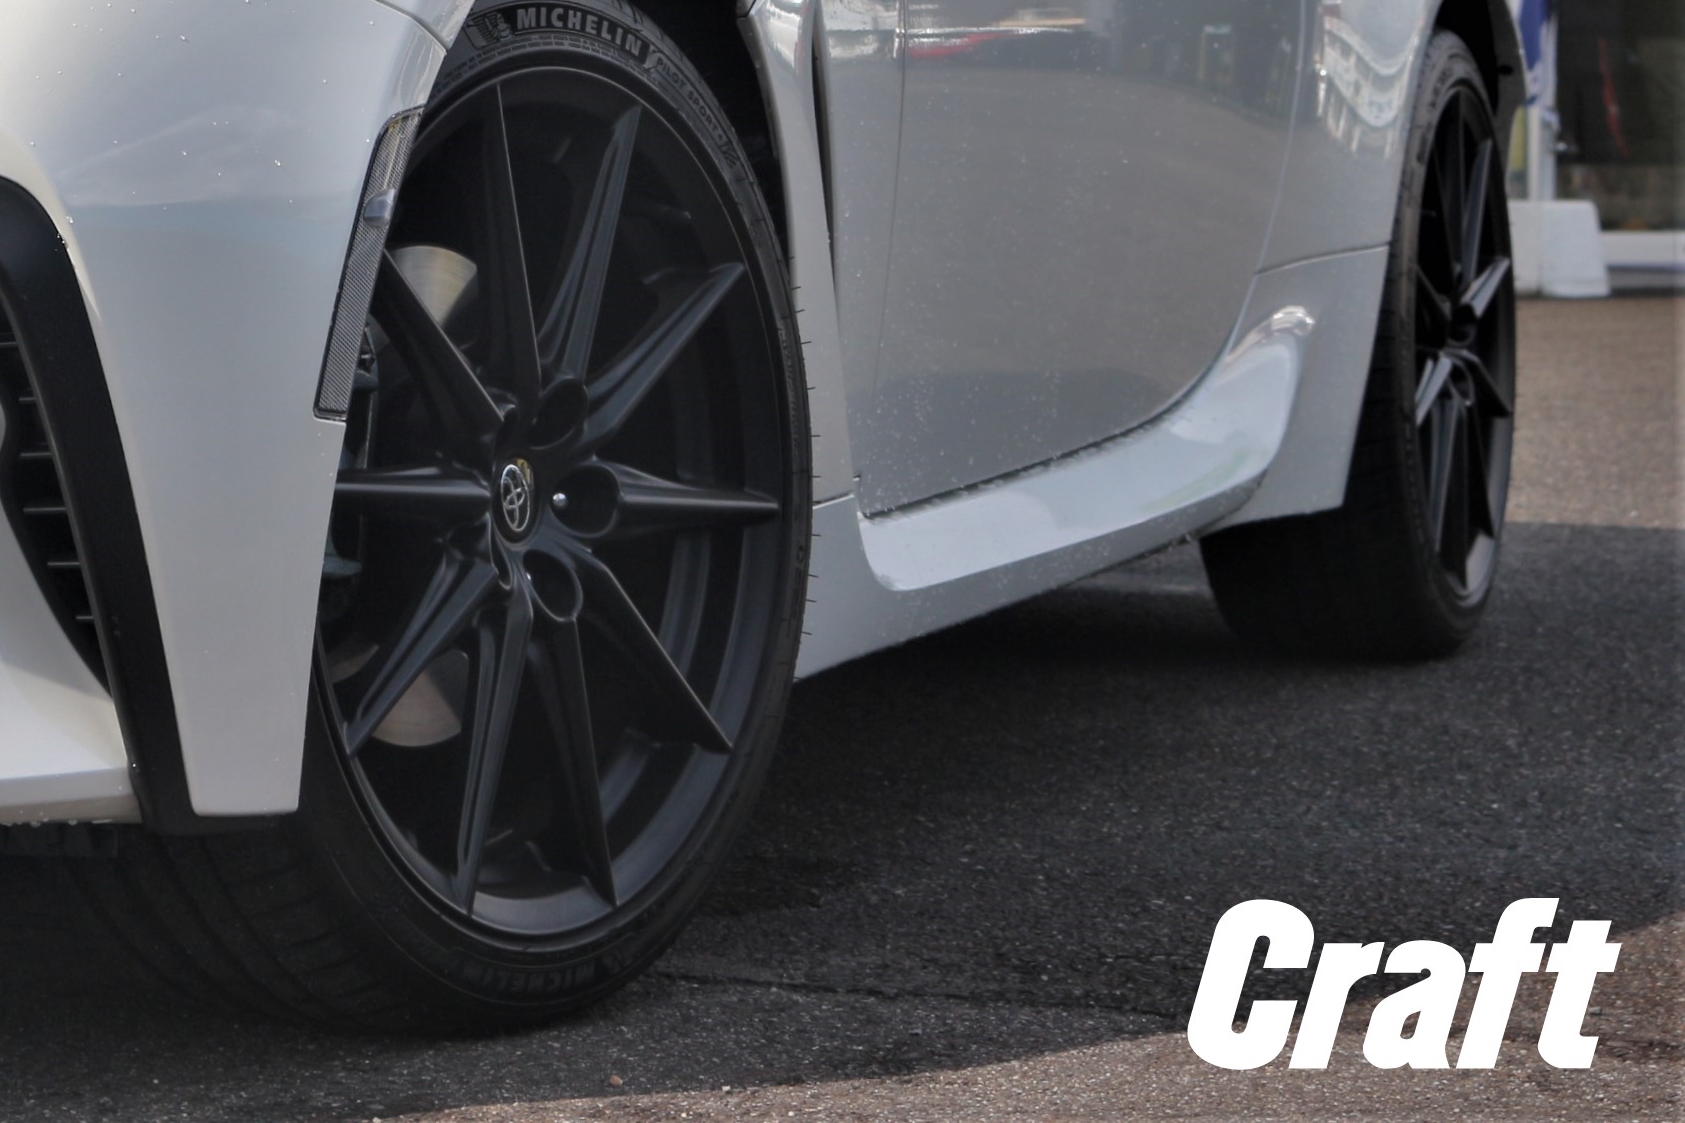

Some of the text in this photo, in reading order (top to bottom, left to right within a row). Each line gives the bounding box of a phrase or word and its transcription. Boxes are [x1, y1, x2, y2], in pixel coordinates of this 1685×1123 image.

[516, 6, 642, 57] MICHELIN
[655, 54, 687, 90] PILOT
[687, 89, 720, 131] SPORT
